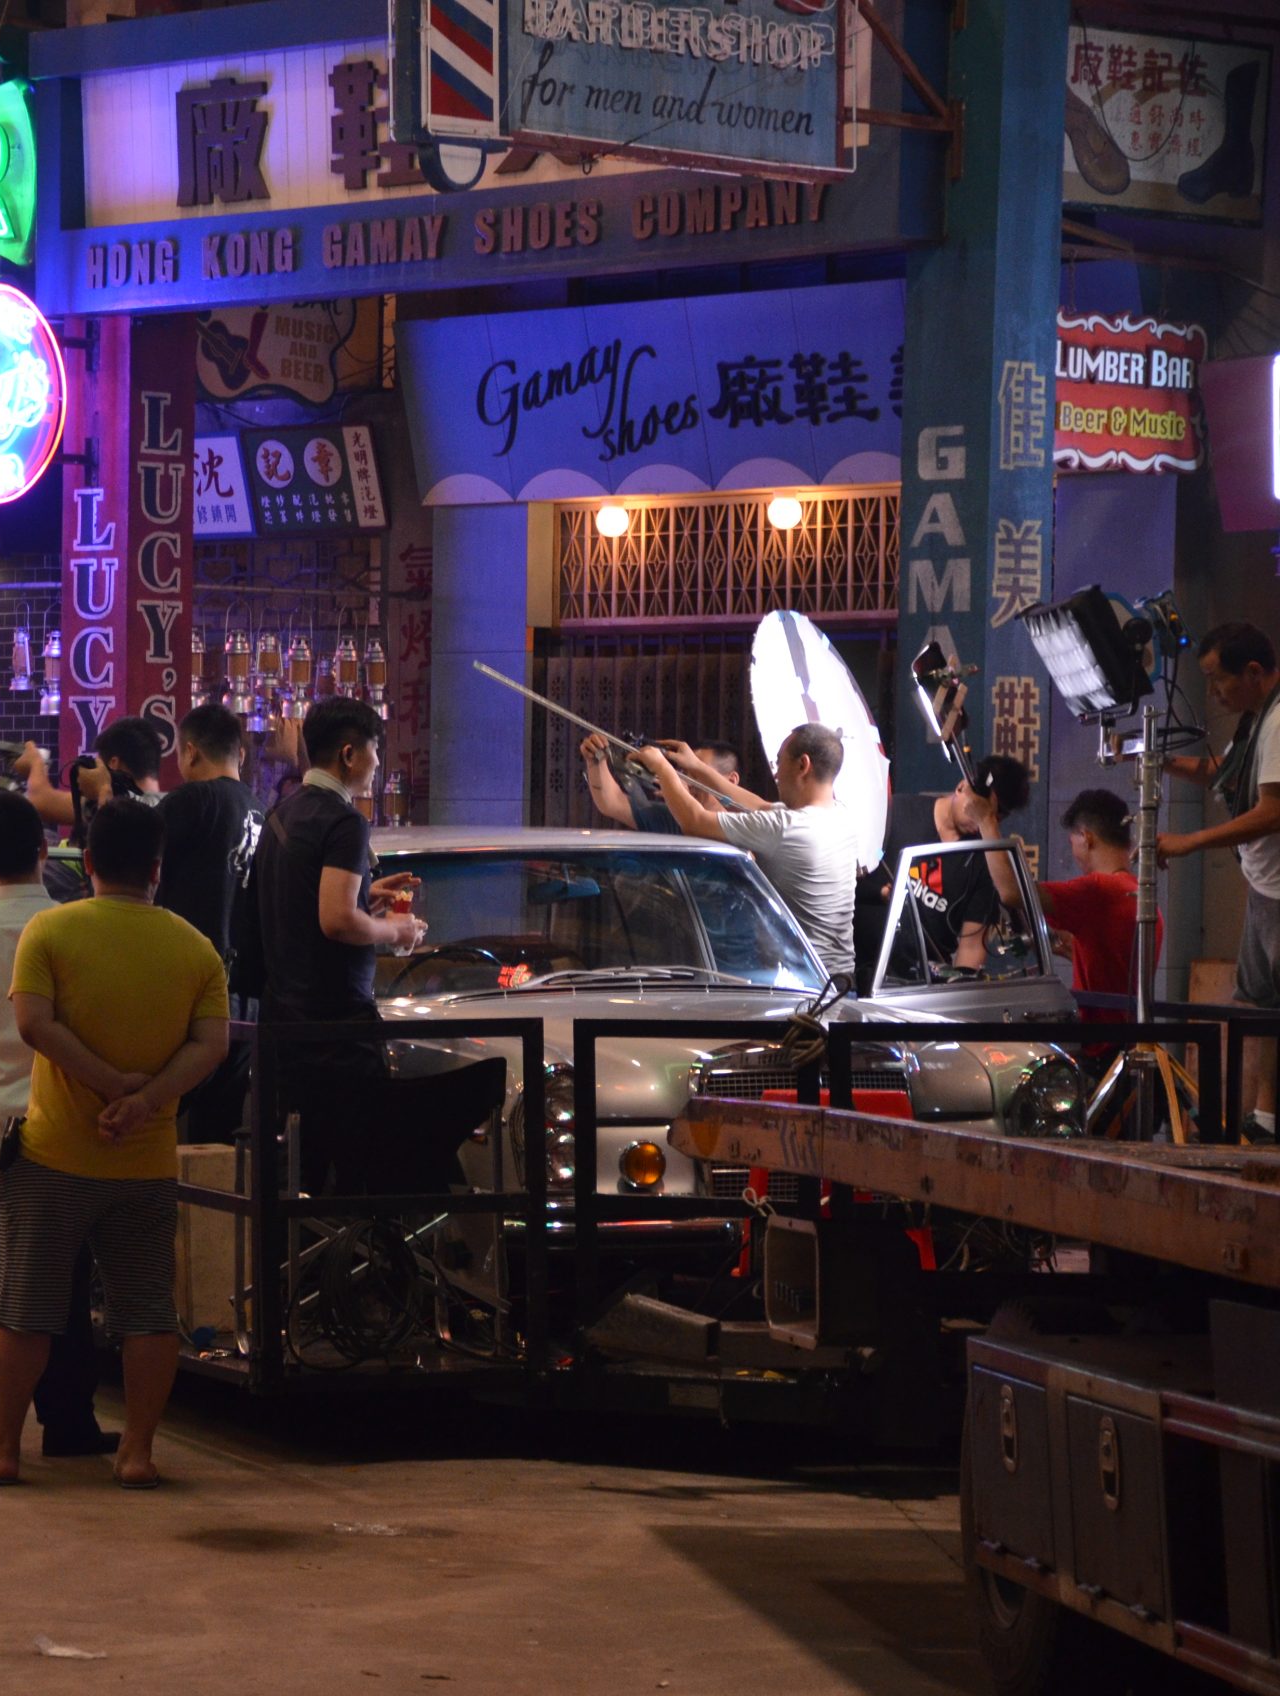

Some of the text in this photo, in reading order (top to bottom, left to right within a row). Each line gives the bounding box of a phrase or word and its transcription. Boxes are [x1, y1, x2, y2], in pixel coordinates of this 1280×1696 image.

[521, 42, 814, 136] for men and women
[86, 180, 830, 290] HONG KONG GAMAY SHOES COMPANY
[274, 315, 336, 344] MUSIC
[289, 341, 318, 360] AND
[281, 358, 325, 383] BEER
[1055, 339, 1144, 385] LUMBER
[476, 338, 622, 458] Gamay
[1060, 401, 1186, 441] Beer & Music
